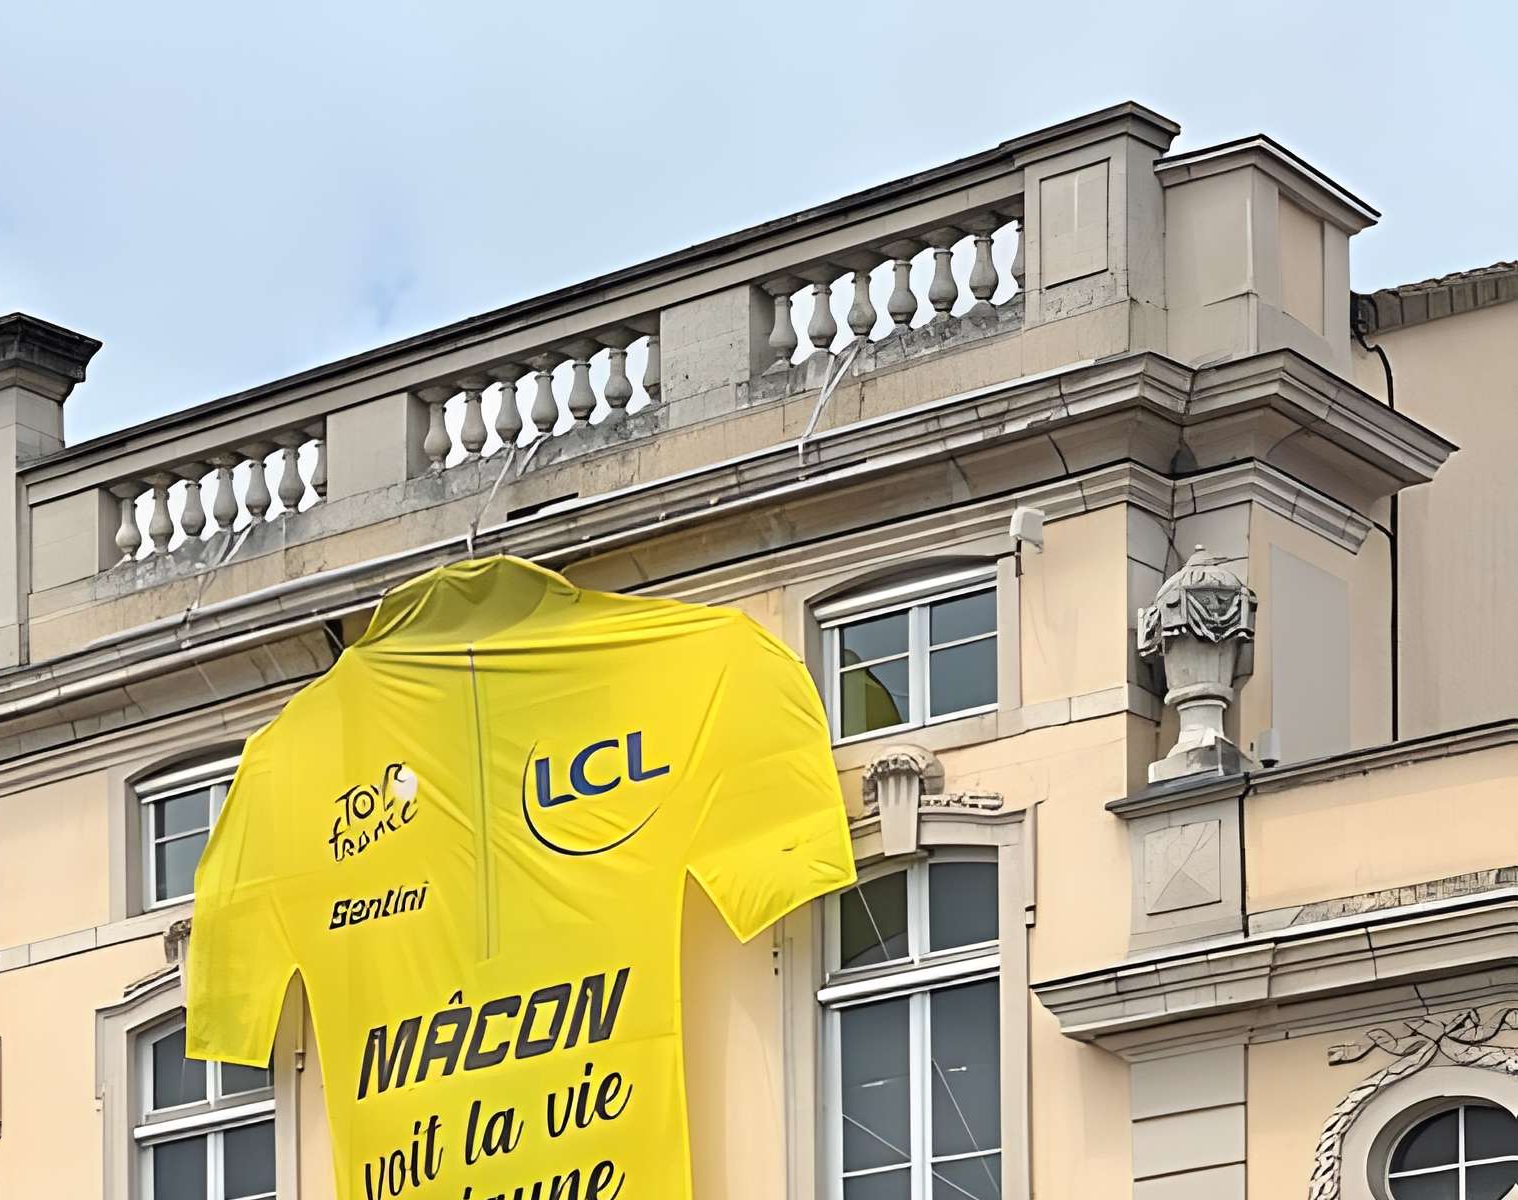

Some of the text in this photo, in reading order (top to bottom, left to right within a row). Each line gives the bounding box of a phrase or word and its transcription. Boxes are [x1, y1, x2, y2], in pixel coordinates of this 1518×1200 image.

[534, 731, 670, 808] LCL
[357, 967, 631, 1100] MÂCON
[465, 1100, 524, 1165] la
[547, 1062, 633, 1138] vie
